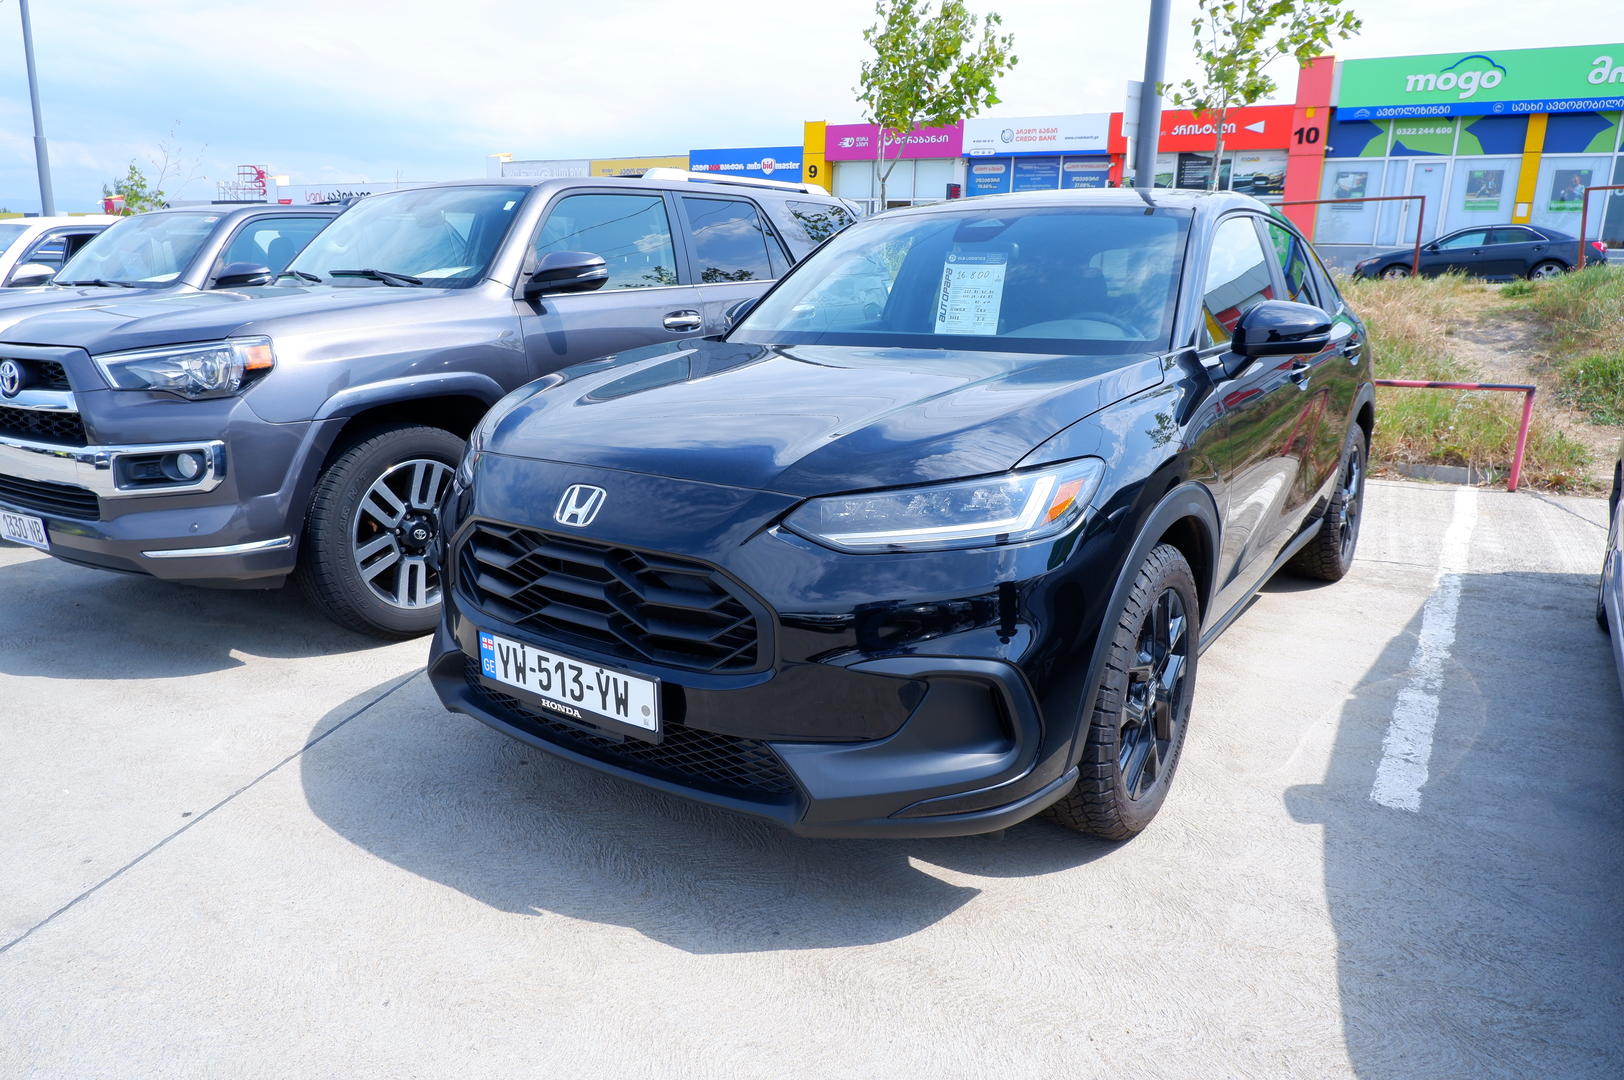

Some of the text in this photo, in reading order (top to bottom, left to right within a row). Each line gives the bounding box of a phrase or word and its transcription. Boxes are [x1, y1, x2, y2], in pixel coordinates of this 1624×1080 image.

[1405, 69, 1503, 100] mogo
[1376, 105, 1451, 117] ავტოლიზინგი
[1511, 102, 1544, 112] სესხი
[1015, 135, 1038, 143] CREDO
[1293, 127, 1320, 145] 10
[808, 165, 818, 179] 9
[482, 657, 496, 675] GE
[497, 643, 629, 718] YW-513-YW
[541, 698, 583, 719] HONDA
